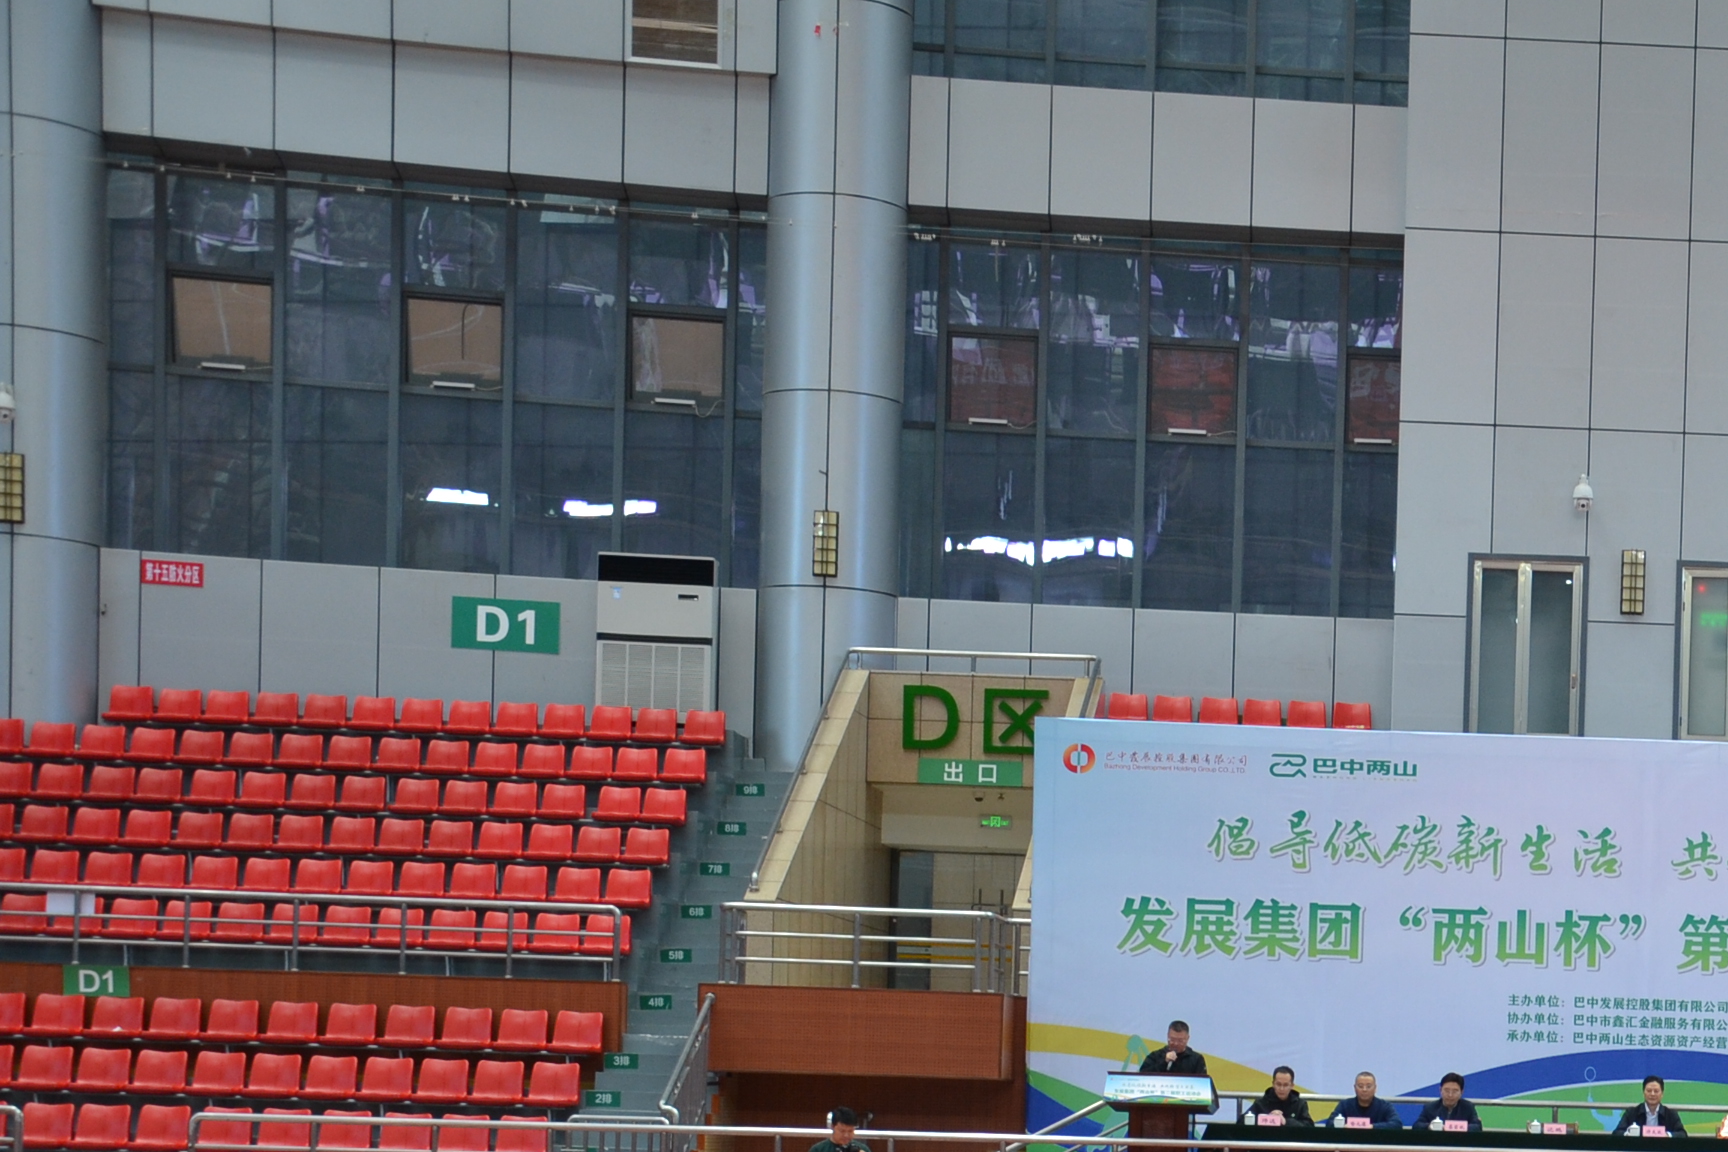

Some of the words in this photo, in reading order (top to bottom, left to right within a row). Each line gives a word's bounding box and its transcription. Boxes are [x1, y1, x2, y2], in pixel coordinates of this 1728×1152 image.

[476, 605, 536, 645] D1
[903, 684, 1049, 754] D区
[943, 761, 998, 783] 出口
[1132, 763, 1172, 771] Development
[1173, 765, 1197, 773] Holding
[1313, 758, 1418, 777] 巴中两山
[1206, 809, 1622, 878] 倡导低碳新生活
[78, 969, 114, 993] D1
